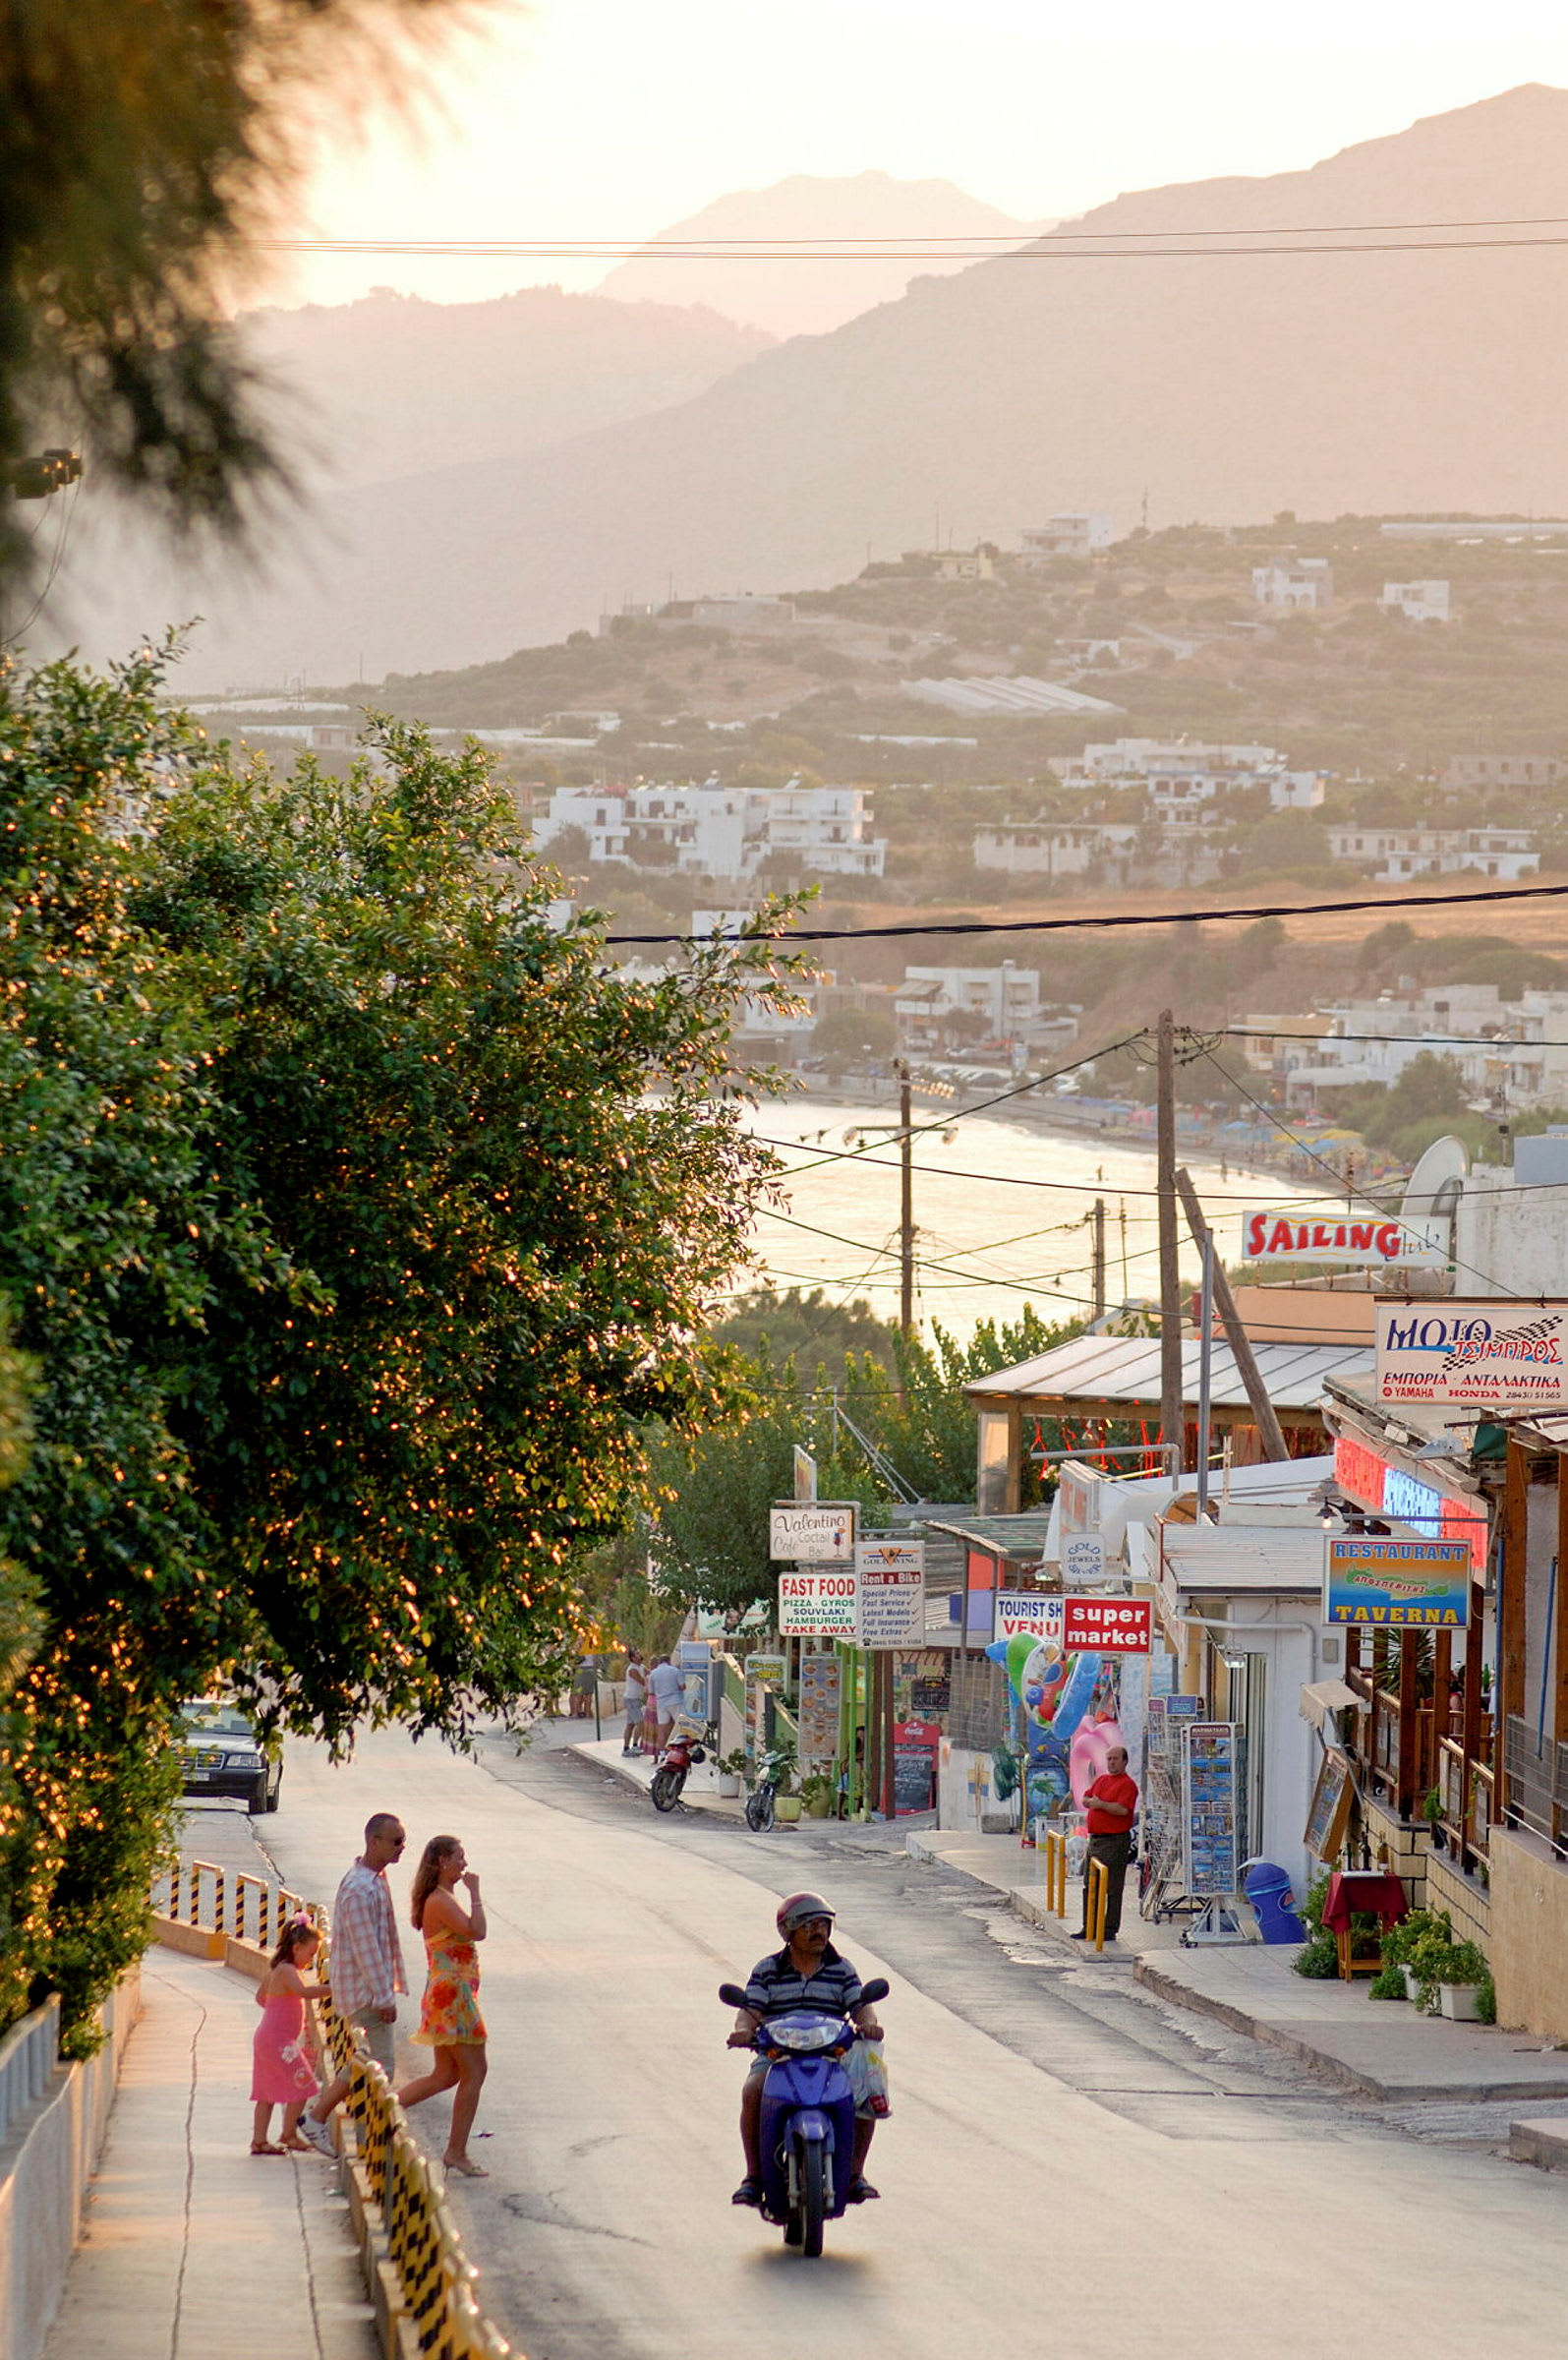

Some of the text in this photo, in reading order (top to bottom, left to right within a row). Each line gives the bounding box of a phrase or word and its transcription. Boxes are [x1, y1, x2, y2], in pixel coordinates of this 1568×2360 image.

[1248, 1213, 1401, 1257] SAILING
[1387, 1319, 1492, 1351] MOTO
[1383, 1372, 1448, 1386] ΕΜΠΟΡΙΑ
[1395, 1386, 1435, 1398] YAMAHA
[1448, 1388, 1501, 1398] HONDA
[775, 1514, 845, 1533] Valentino
[1068, 1542, 1101, 1555] GOLD
[1334, 1543, 1466, 1561] RESTAURANT
[861, 1572, 920, 1584] Rent a Bike
[782, 1578, 855, 1596] FAST FOOD
[862, 1588, 910, 1599] Special Prices
[784, 1599, 813, 1608] PIZZA
[821, 1599, 855, 1608] GYROS
[880, 1598, 905, 1607] Service
[998, 1601, 1045, 1617] TOURIST
[862, 1608, 910, 1618] Latest Models
[1072, 1607, 1145, 1626] super
[1334, 1605, 1459, 1624] TAVERNA
[862, 1627, 878, 1636] Free
[1003, 1620, 1060, 1637] VENU
[1067, 1628, 1148, 1646] market
